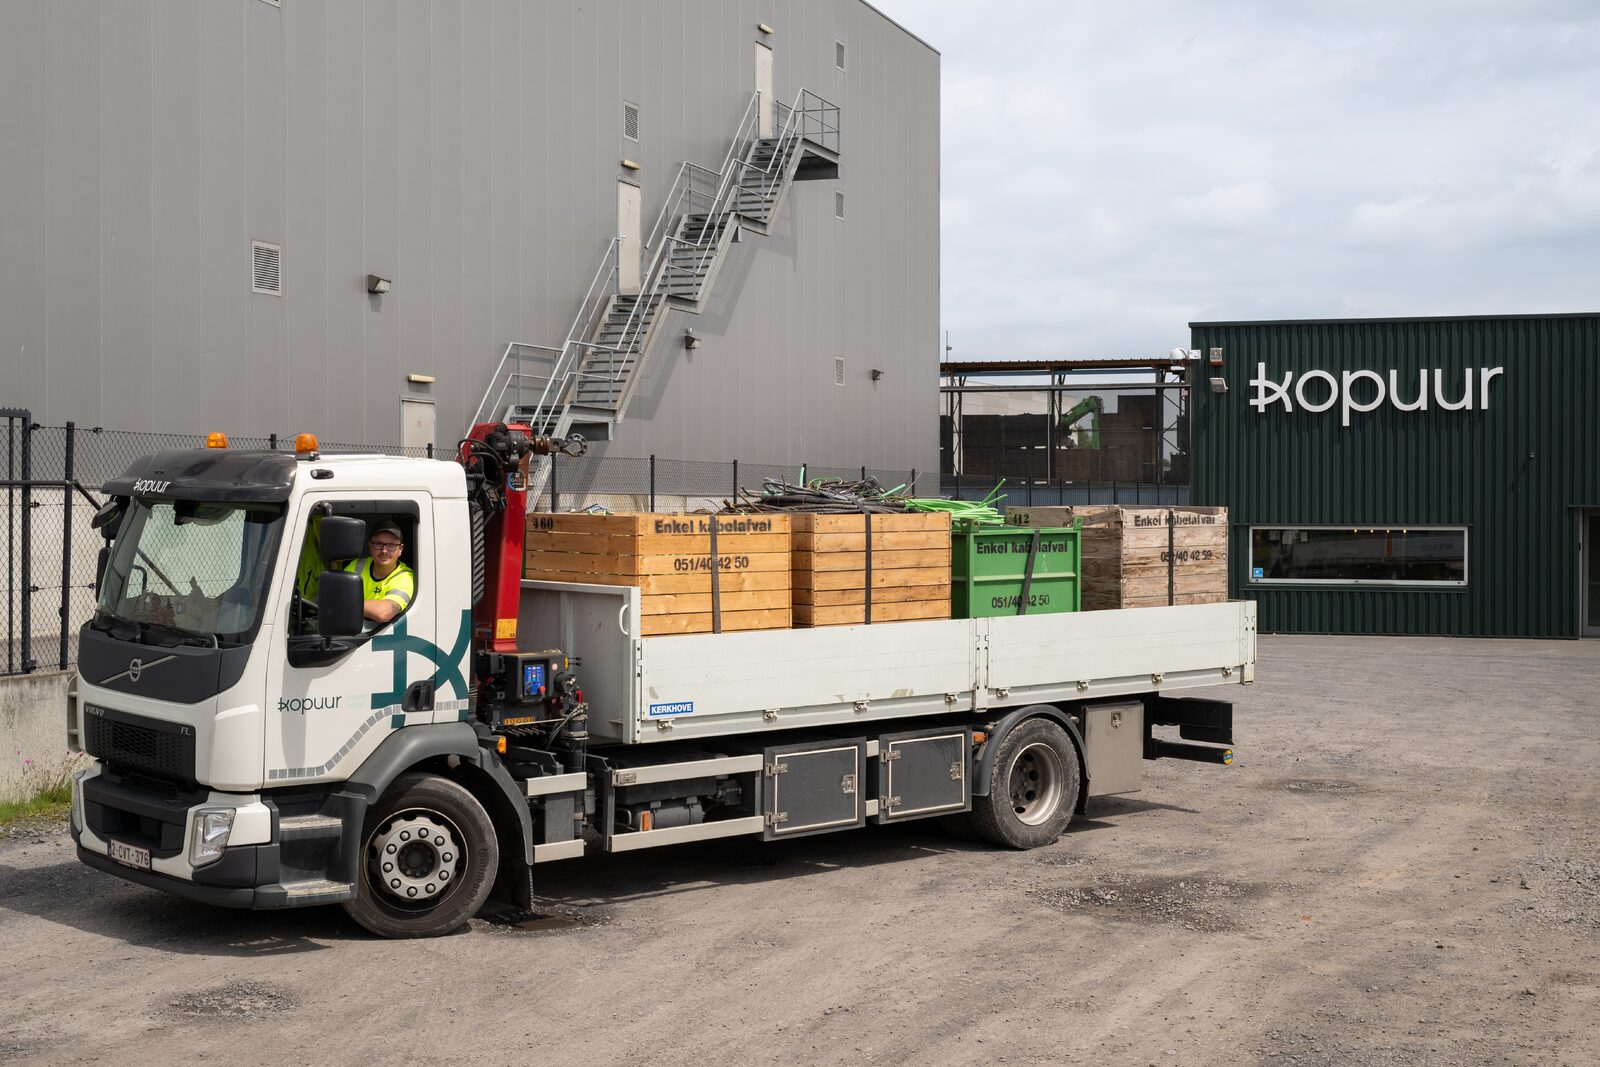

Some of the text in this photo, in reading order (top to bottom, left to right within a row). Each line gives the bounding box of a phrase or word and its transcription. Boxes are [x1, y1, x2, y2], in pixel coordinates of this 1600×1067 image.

[1250, 362, 1503, 426] kopuur
[533, 516, 553, 529] 460
[655, 519, 694, 533] Enkel
[1134, 514, 1161, 527] Enkel
[976, 540, 1067, 554] Enkel kablafval
[734, 556, 749, 568] 50
[1039, 594, 1050, 606] 50
[85, 704, 104, 717] VOLVO
[278, 695, 342, 715] kopuur
[651, 703, 692, 714] KERKHOVE
[180, 726, 191, 736] FL
